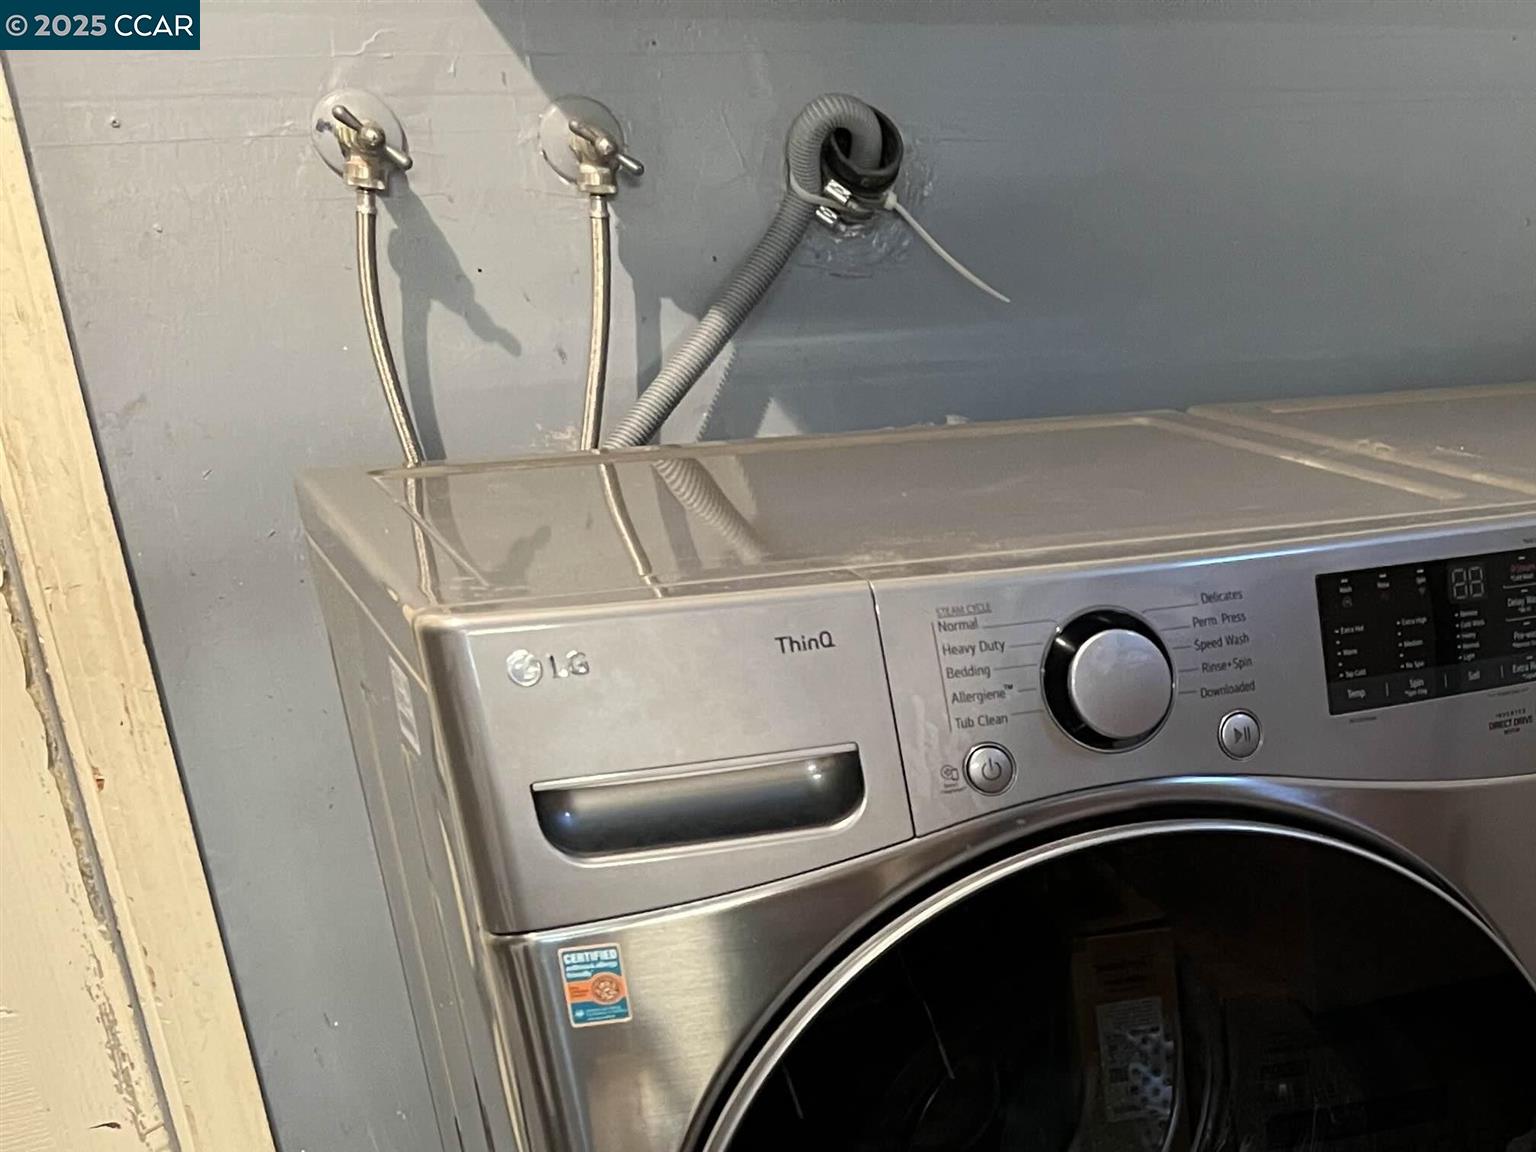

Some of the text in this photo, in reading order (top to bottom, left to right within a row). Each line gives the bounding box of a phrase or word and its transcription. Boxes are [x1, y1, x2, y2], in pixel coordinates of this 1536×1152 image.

[1200, 591, 1243, 605] Delicates
[938, 616, 979, 633] Normal
[1221, 612, 1247, 625] Press
[774, 630, 836, 655] ThinQ
[942, 640, 1005, 657] Heavy Duty
[1194, 633, 1250, 653] Speed Wash
[547, 649, 590, 679] LG
[946, 665, 991, 679] Bedding
[1200, 680, 1255, 698] Downloaded
[955, 714, 1009, 729] Tub Clean
